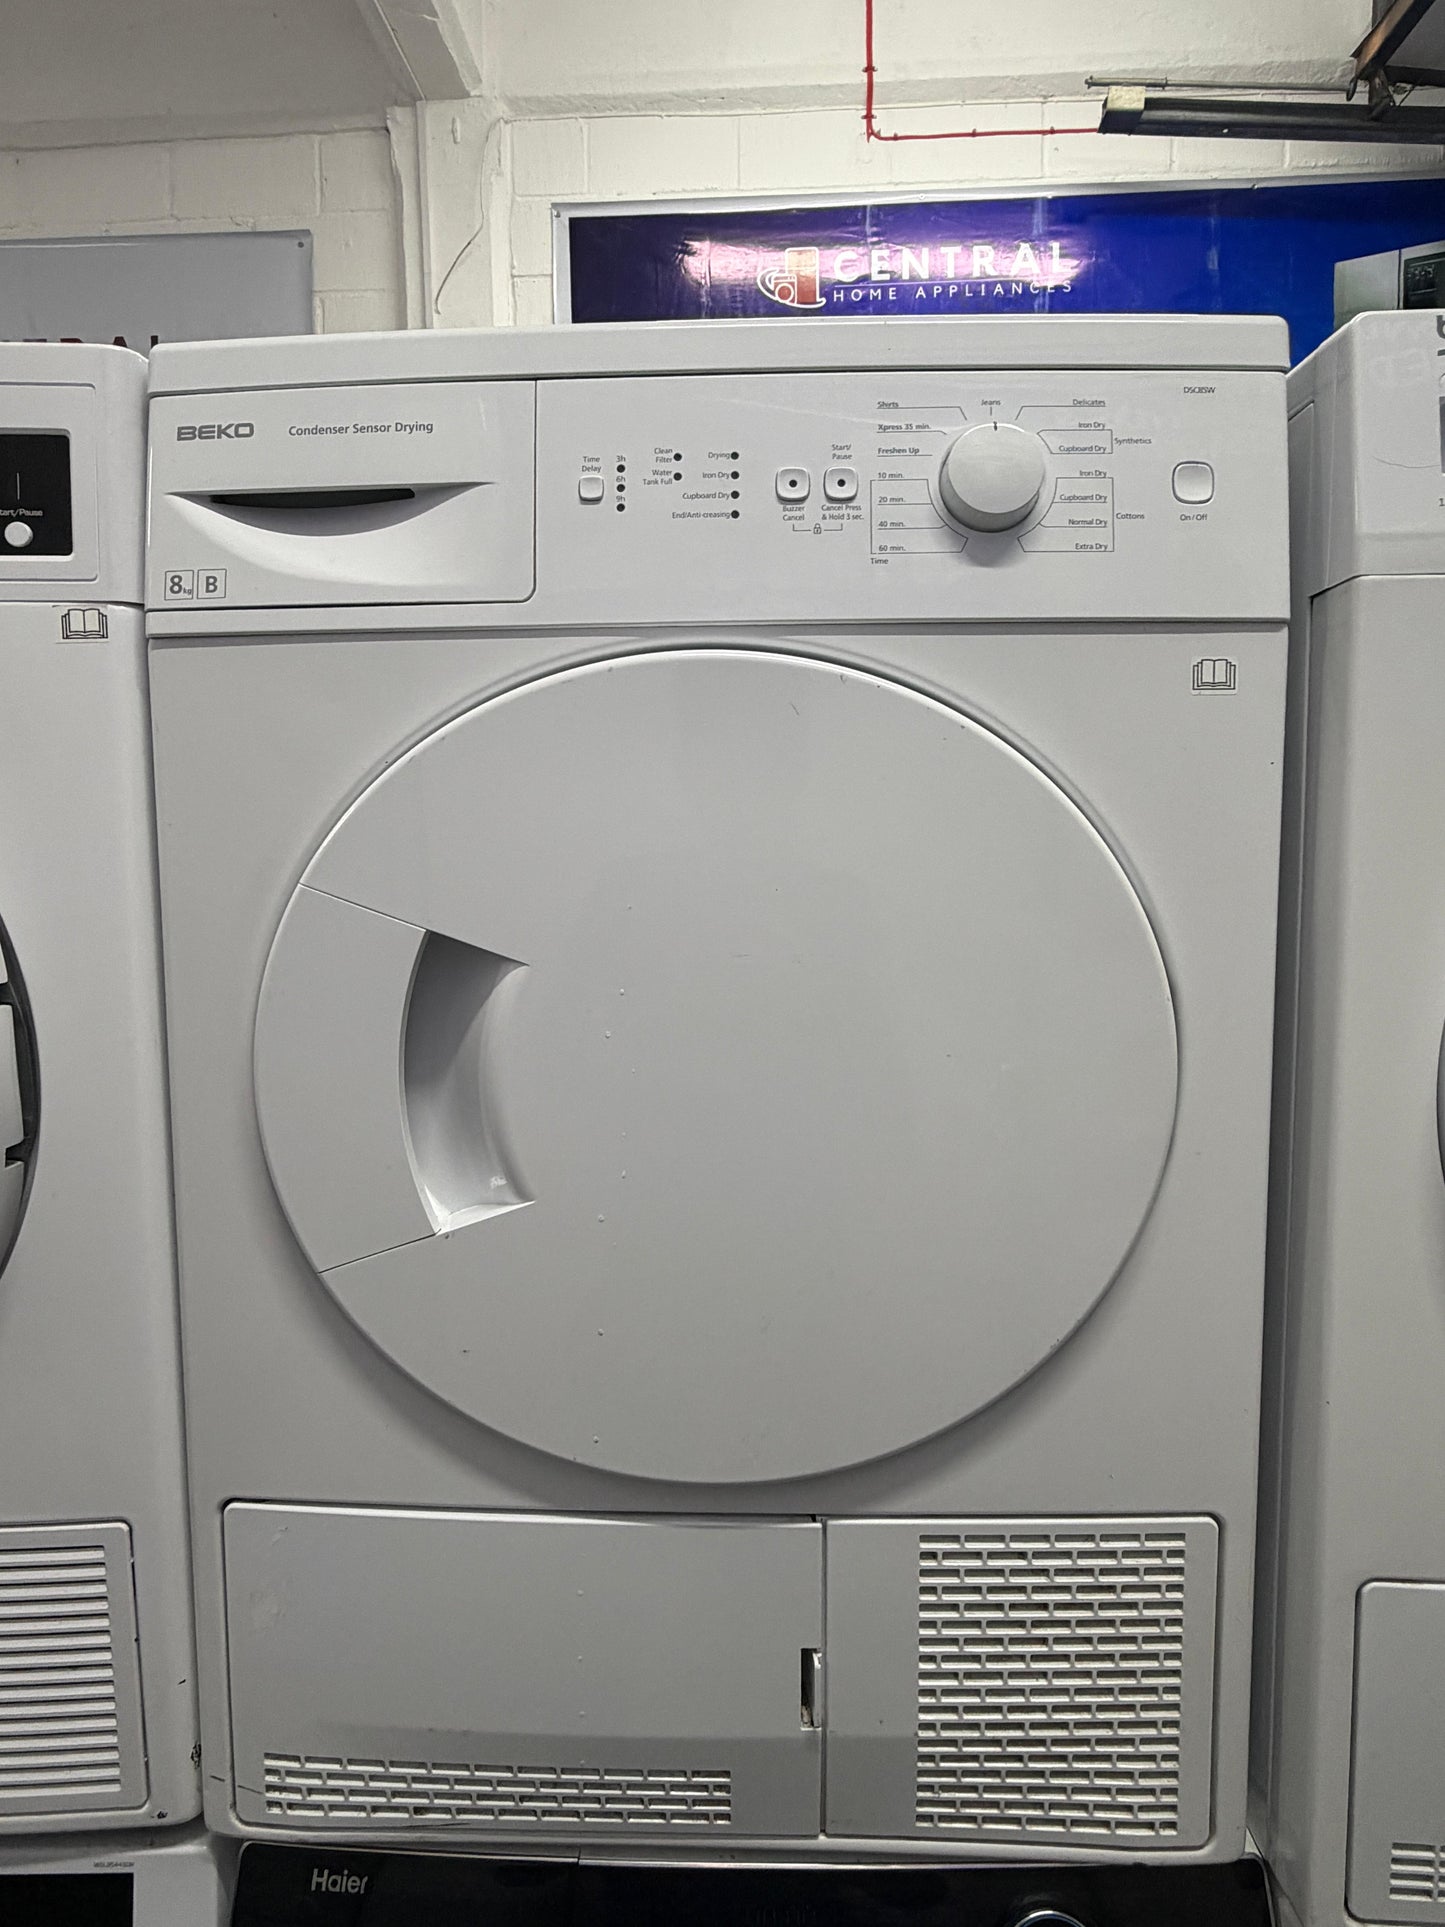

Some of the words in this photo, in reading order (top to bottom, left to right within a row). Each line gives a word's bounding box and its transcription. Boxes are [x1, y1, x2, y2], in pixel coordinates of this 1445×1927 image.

[832, 242, 1072, 282] CENTRAL
[833, 286, 898, 303] HOME
[915, 281, 1073, 299] APPLIANCES
[877, 400, 900, 408] Shirts
[1072, 398, 1106, 406] Delicates
[288, 423, 350, 437] Condenser
[352, 422, 393, 434] Sensor
[394, 421, 434, 434] Drying
[877, 423, 903, 432] Xpress
[1078, 421, 1092, 429] Iron
[1093, 421, 1106, 430] Dry
[176, 422, 255, 442] BEKO
[1114, 436, 1153, 446] Synthetics
[654, 447, 673, 455] Clean
[831, 443, 852, 451] Start/
[1058, 444, 1092, 454] Cupboard
[1094, 444, 1107, 454] Dry
[877, 447, 906, 455] Freshen
[908, 447, 920, 456] Up
[615, 455, 626, 463] 3h
[708, 451, 731, 461] Drying
[581, 465, 602, 473] Delay
[651, 469, 672, 477] Water
[702, 471, 716, 479] Iron
[717, 471, 731, 480] Dry
[878, 471, 887, 479] 10
[888, 471, 905, 479] min.
[1079, 469, 1093, 477] Iron
[1094, 469, 1107, 479] Dry
[615, 475, 626, 483] 6h
[642, 478, 661, 486] Tank
[615, 495, 626, 503] 9h
[682, 492, 717, 501] Cupboard
[718, 492, 731, 501] Dry
[889, 495, 906, 503] min.
[1059, 493, 1093, 503] Cupboard
[1095, 493, 1108, 503] Dry
[782, 504, 806, 512] Buzzer
[821, 504, 844, 512] Cancel
[0, 508, 43, 517] tart/Pause
[671, 511, 731, 520] End/Anti-creasing
[1115, 512, 1145, 520] Cottons
[782, 513, 805, 521] Cancel
[821, 513, 828, 521] &
[828, 513, 845, 521] Hold
[1180, 513, 1191, 521] On
[1196, 513, 1208, 521] Off
[878, 520, 887, 528] 40
[888, 520, 905, 528] min.
[1068, 518, 1094, 526] Normal
[1095, 518, 1108, 527] Dry
[878, 544, 887, 552] 60
[889, 544, 906, 552] min.
[1075, 542, 1094, 551] Extra
[1095, 542, 1109, 552] Dry
[870, 557, 889, 565] Time
[204, 575, 218, 594] B
[310, 1867, 369, 1894] Haier
